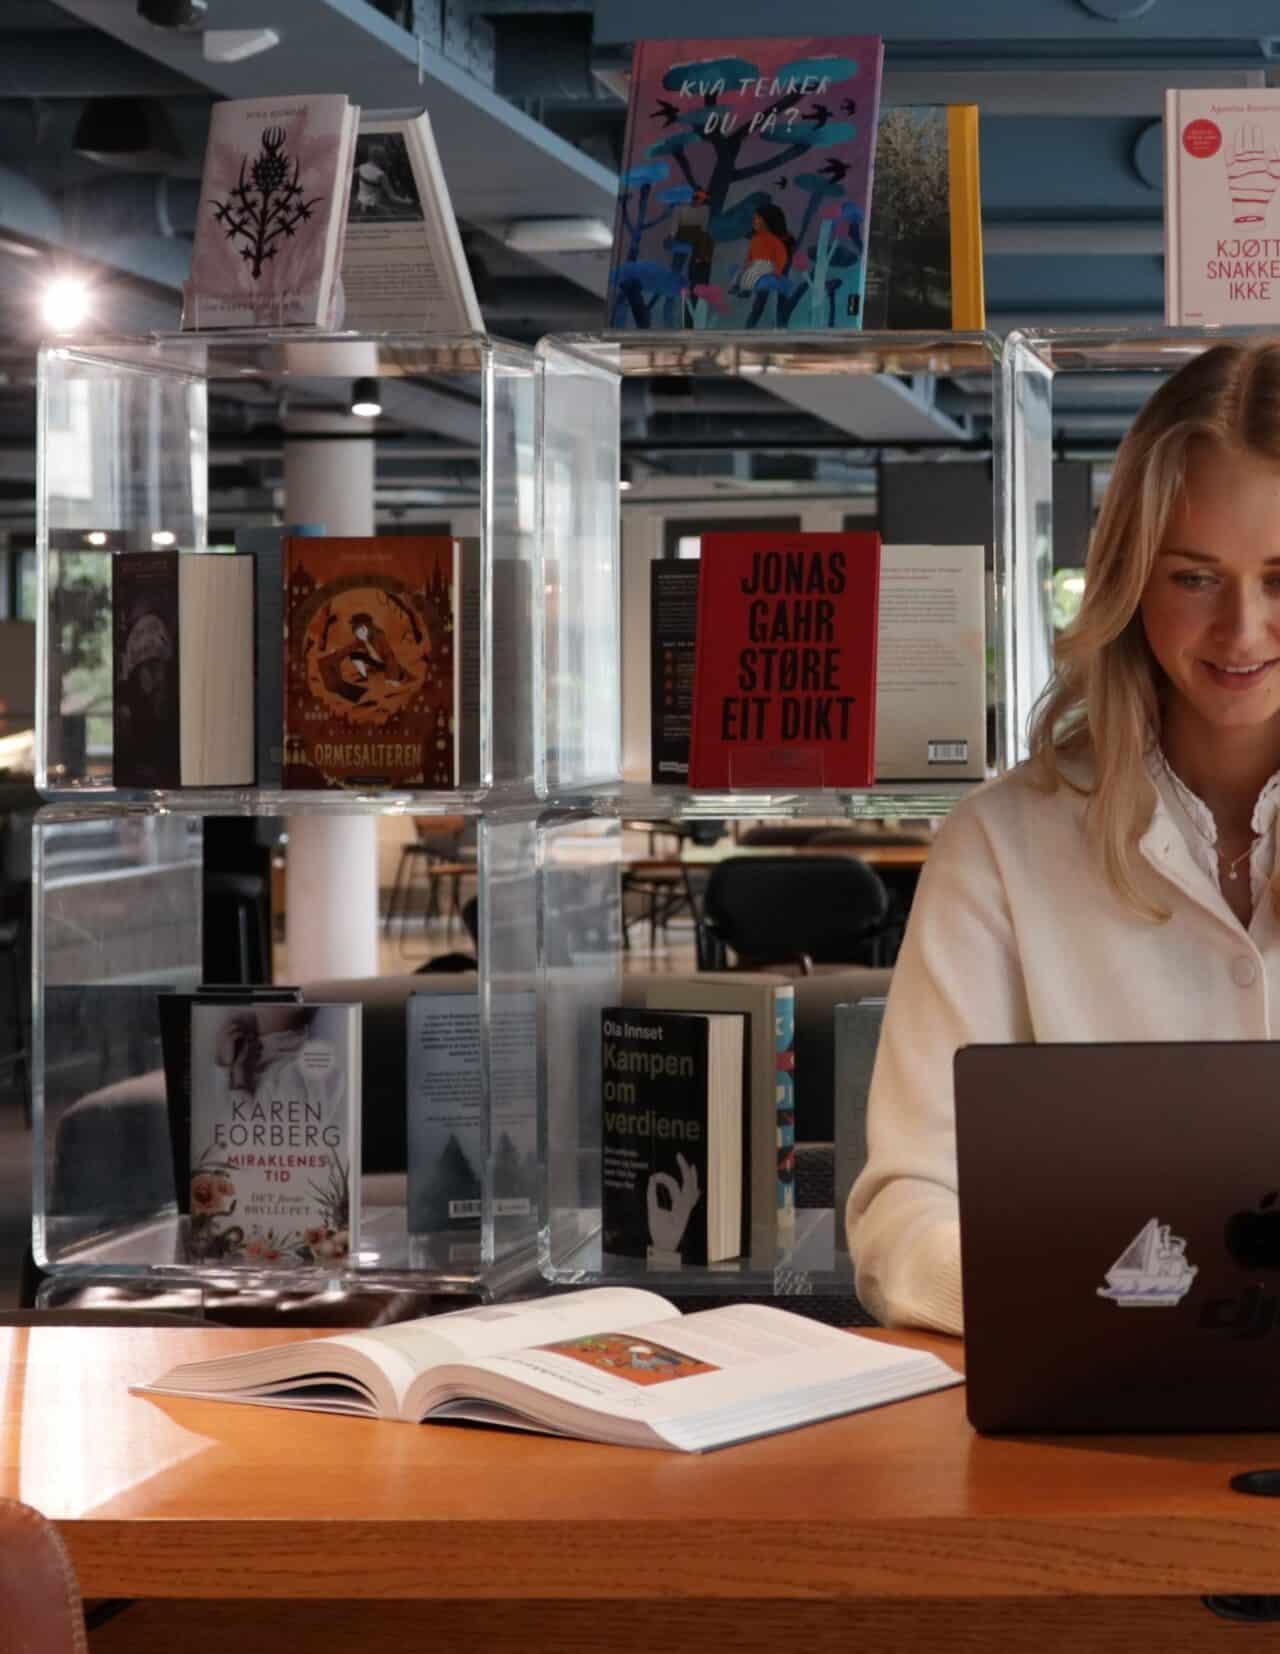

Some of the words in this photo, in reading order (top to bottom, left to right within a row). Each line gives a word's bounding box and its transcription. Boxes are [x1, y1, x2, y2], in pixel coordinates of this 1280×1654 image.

[679, 78, 726, 98] KVA
[738, 75, 833, 97] TENKER
[703, 111, 737, 135] DU
[1229, 281, 1271, 300] IKKE
[741, 551, 847, 595] JONAS
[749, 600, 835, 643] GAHR
[738, 648, 841, 692] STØRE
[720, 697, 772, 741] EIT
[780, 697, 857, 742] DIKT
[314, 743, 422, 766] ORMESALTEREN
[603, 1020, 623, 1038] Ola
[624, 1023, 664, 1041] Innset
[603, 1042, 694, 1079] Kampen
[603, 1082, 636, 1104] om
[231, 1100, 323, 1123] KAREN
[214, 1124, 342, 1148] FORBERG
[603, 1110, 701, 1141] verdiene
[227, 1155, 327, 1169] MIRAKLENES
[264, 1170, 291, 1183] TID
